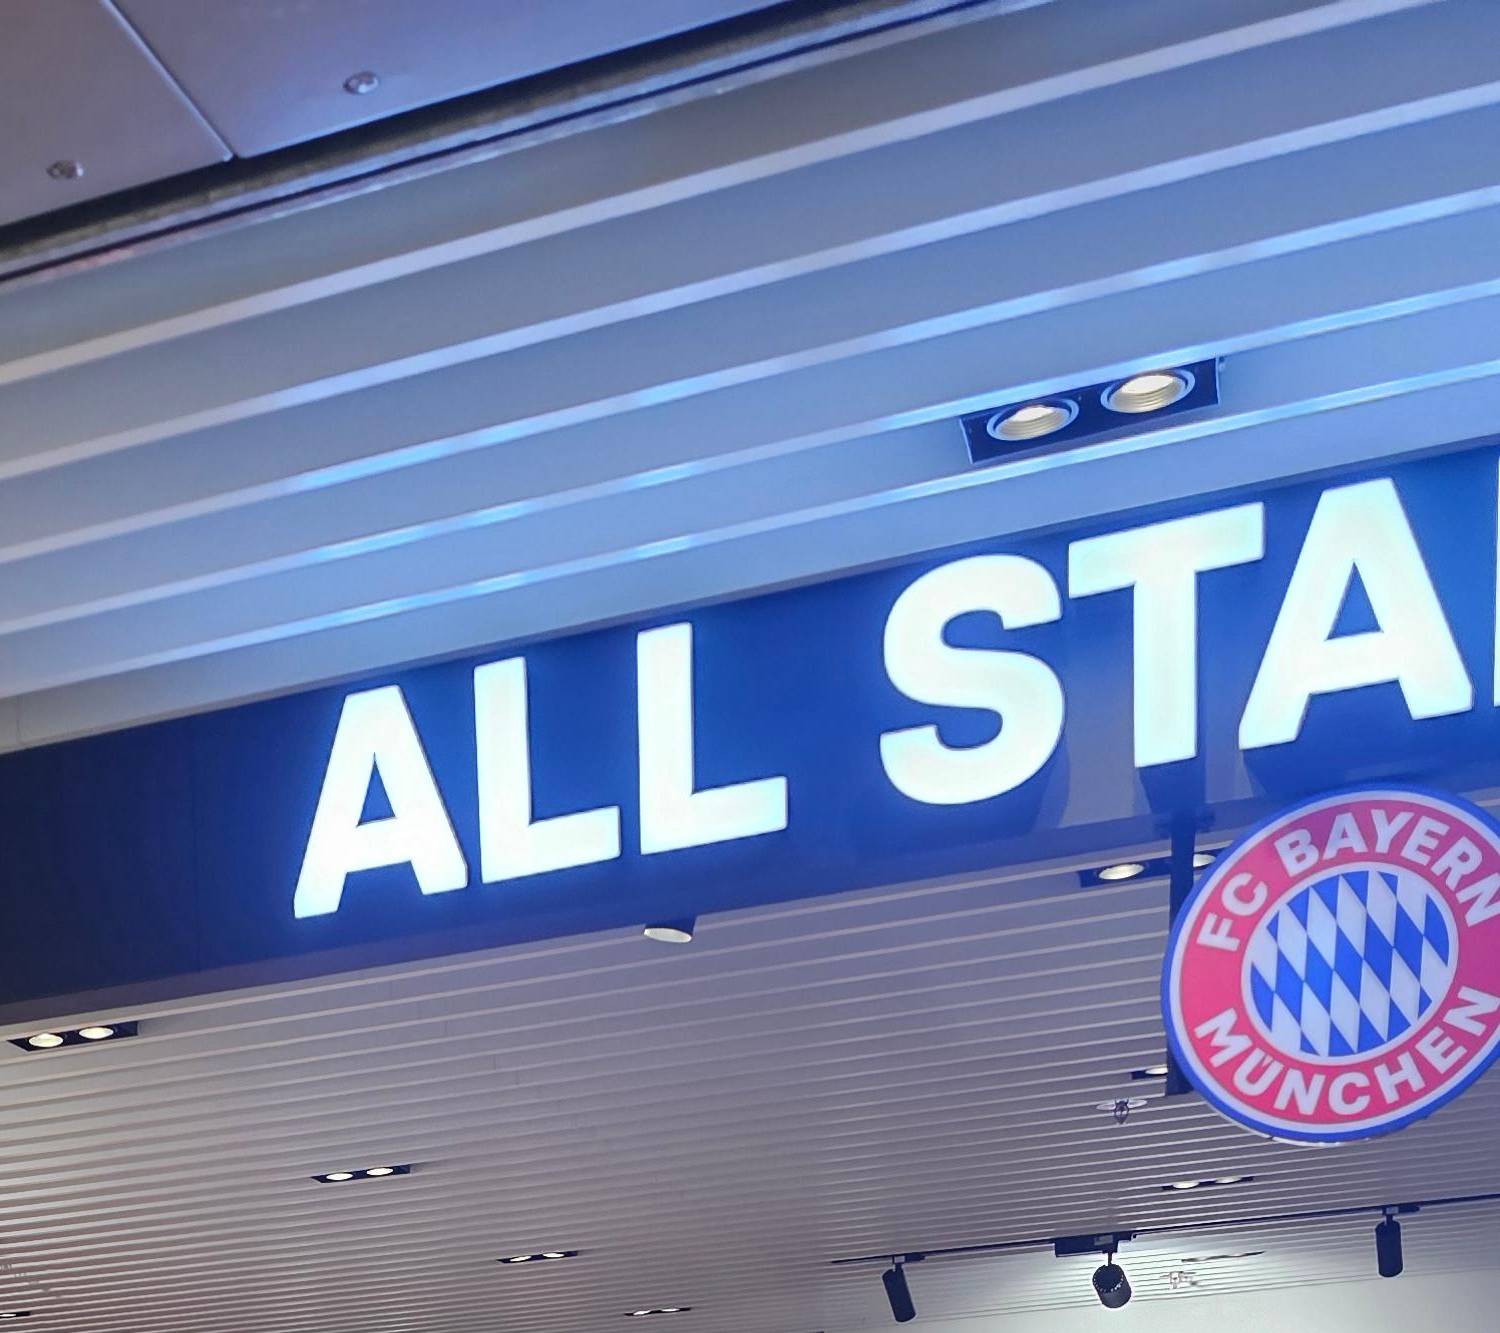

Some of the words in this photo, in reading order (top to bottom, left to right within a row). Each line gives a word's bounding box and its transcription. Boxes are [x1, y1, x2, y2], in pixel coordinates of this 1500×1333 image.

[294, 618, 789, 921] ALL
[879, 462, 1500, 806] STA
[1196, 871, 1268, 952] FC
[1273, 808, 1500, 929] BAYERN
[1194, 984, 1500, 1117] MÜNCHEN
